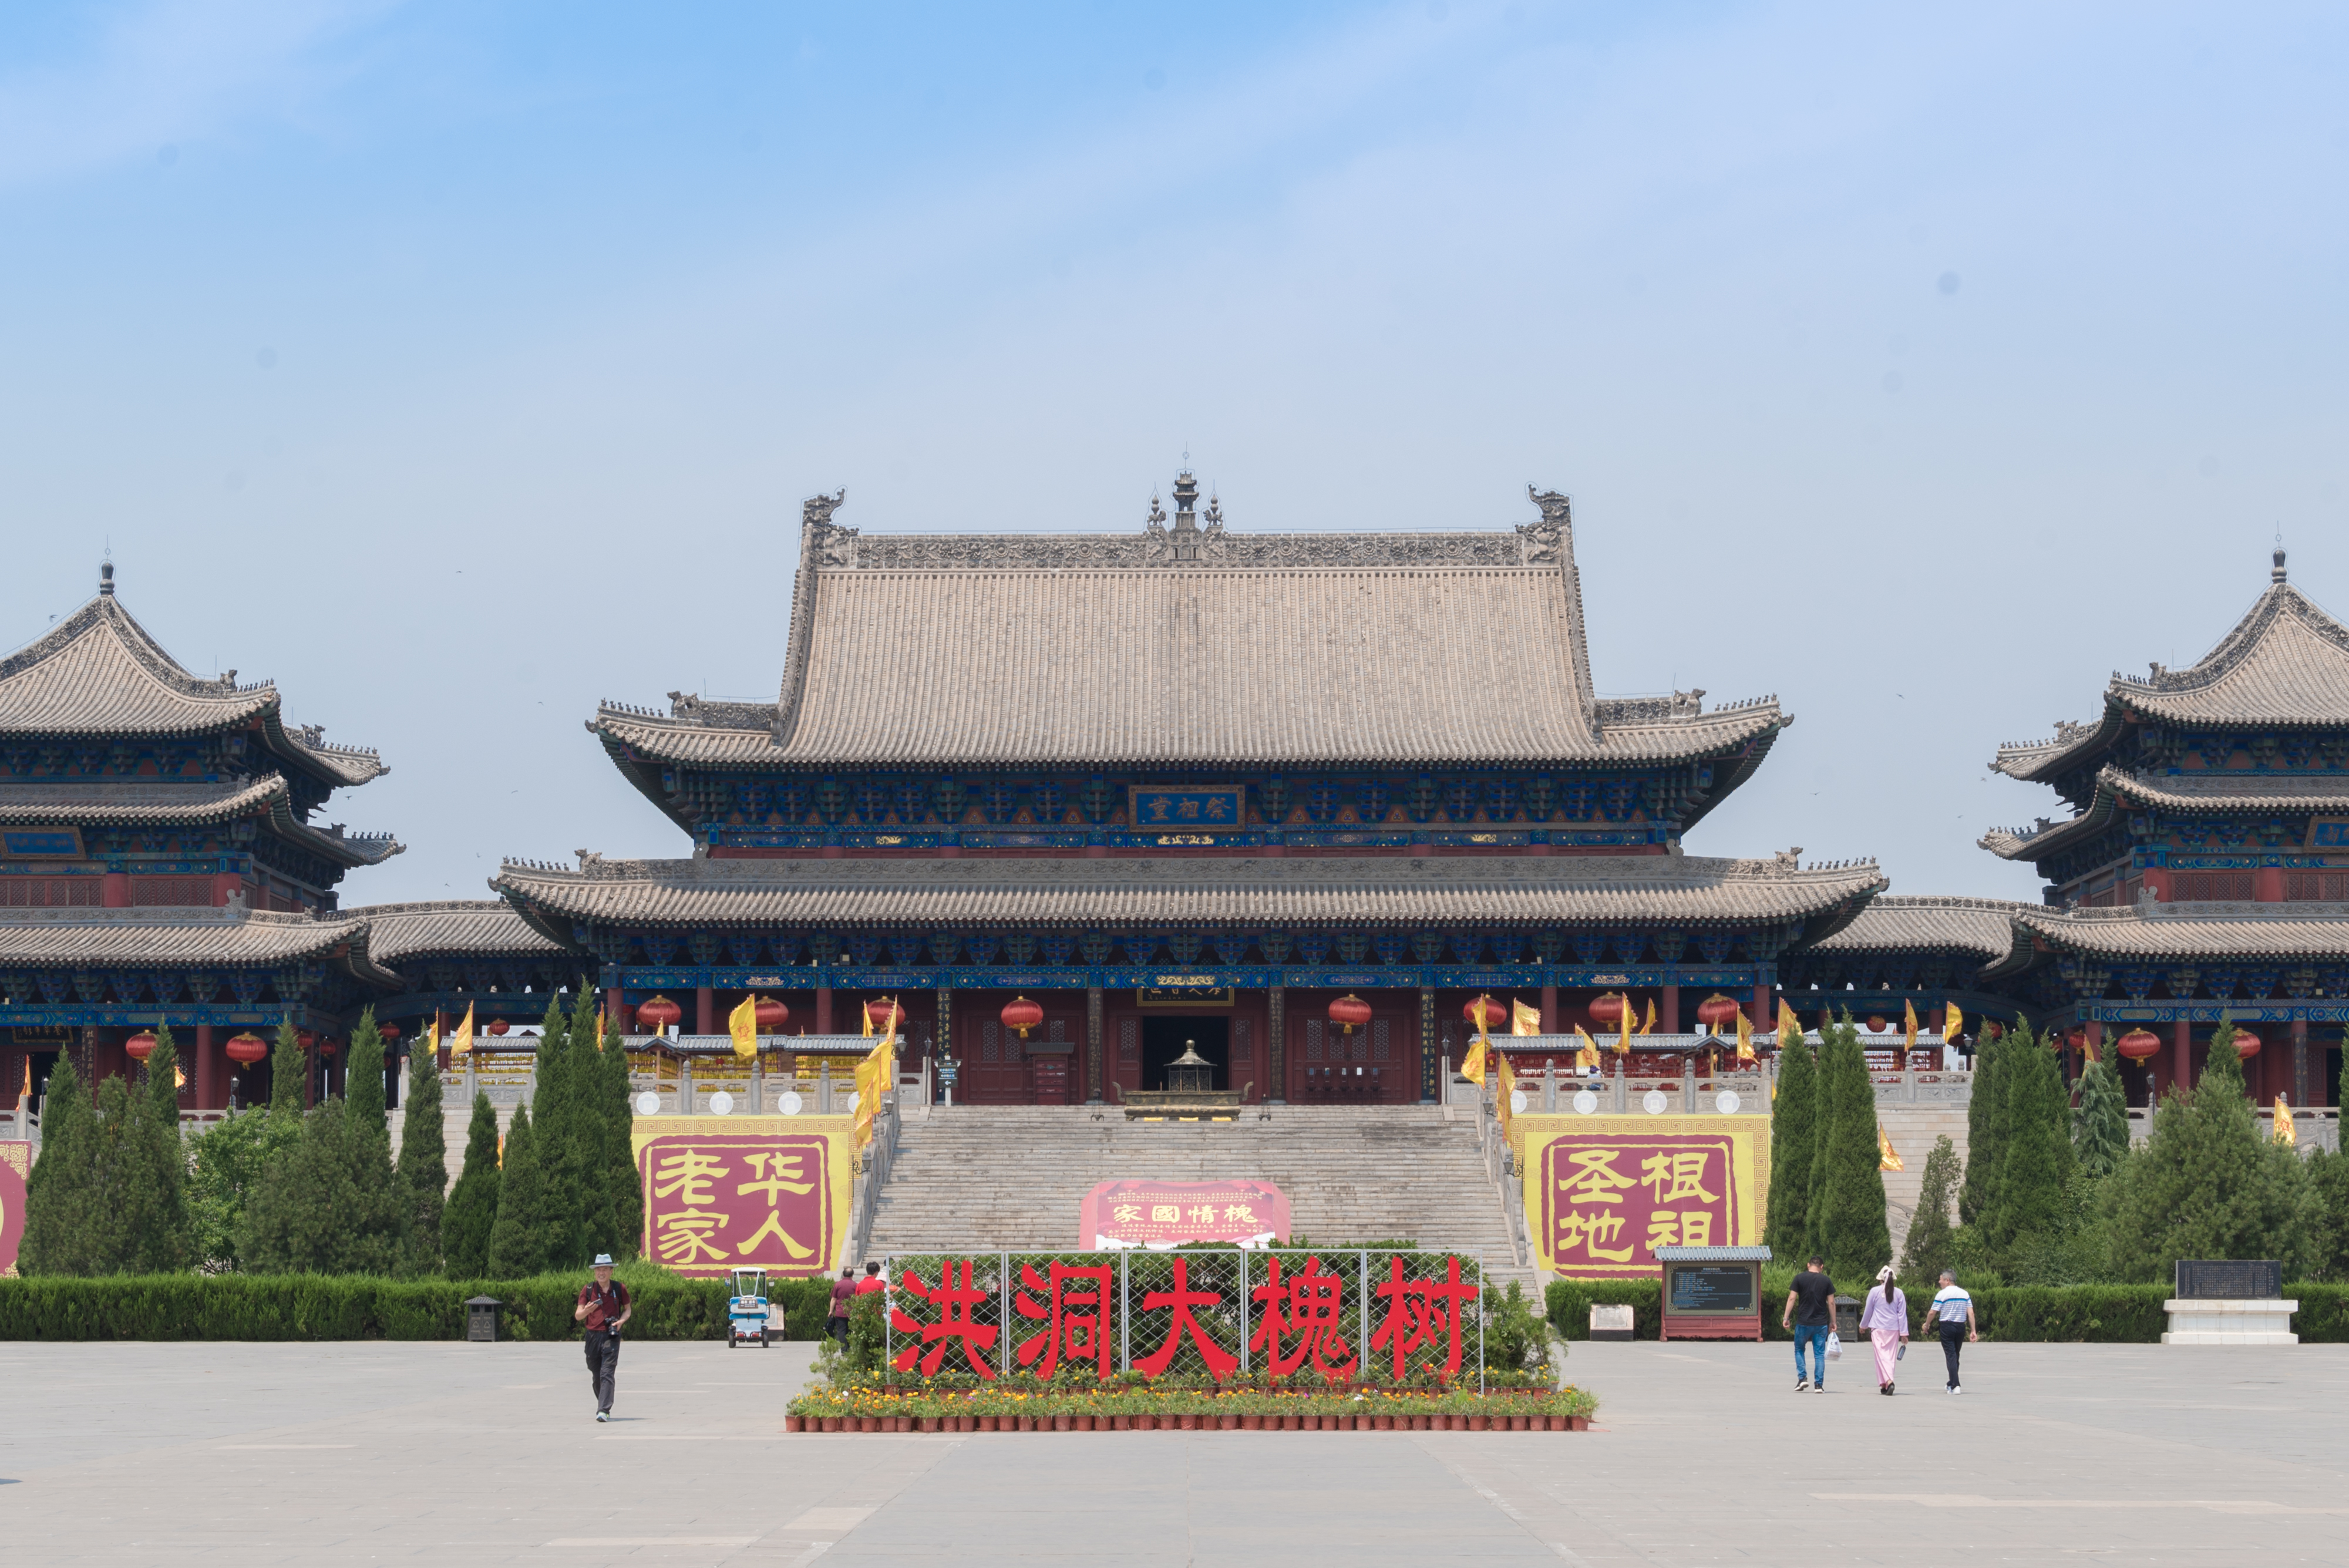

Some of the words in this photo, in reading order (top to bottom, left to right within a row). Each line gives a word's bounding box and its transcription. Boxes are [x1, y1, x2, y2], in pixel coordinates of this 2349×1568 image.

[1147, 795, 1231, 820] 祭祖堂
[1113, 1204, 1258, 1224] 家國情槐
[891, 1256, 1479, 1385] 洪洞大槐树
